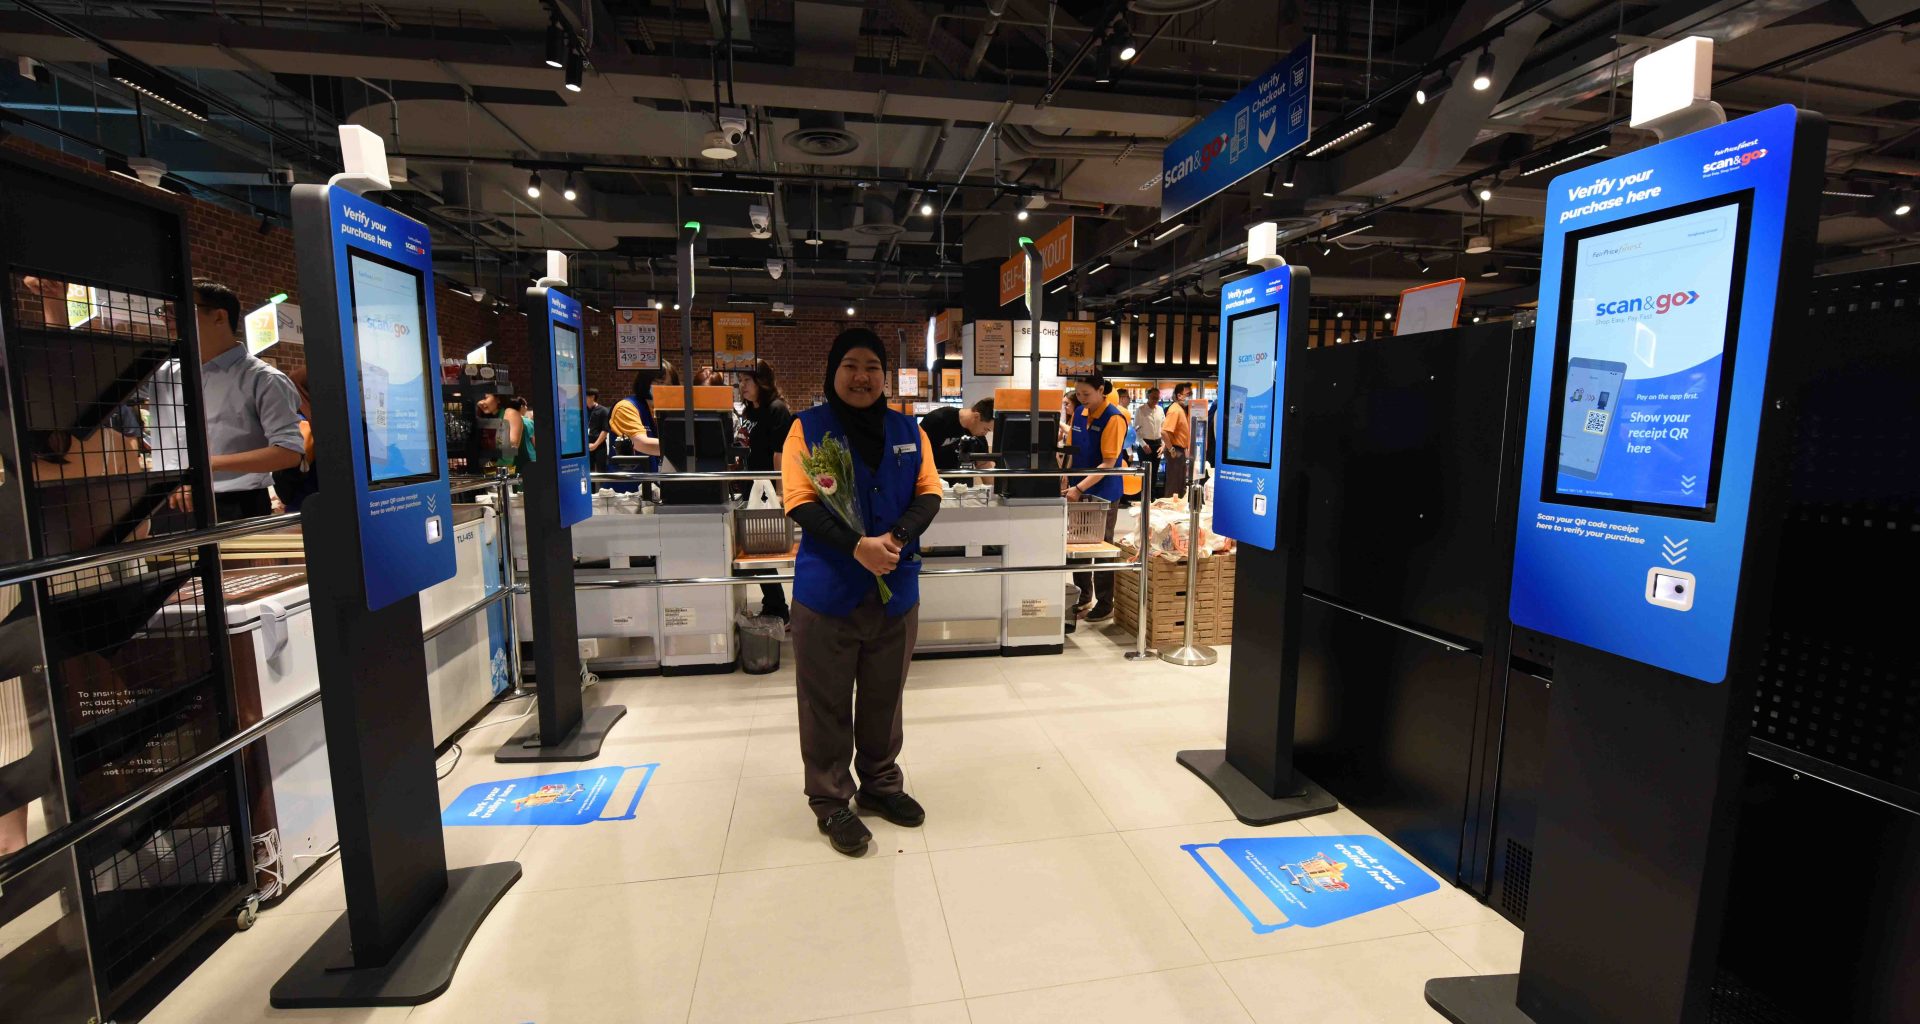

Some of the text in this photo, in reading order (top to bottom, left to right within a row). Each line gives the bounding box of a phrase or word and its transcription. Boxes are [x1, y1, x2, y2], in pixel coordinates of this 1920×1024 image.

[1259, 72, 1280, 95] Verify
[1252, 83, 1286, 113] Checkout
[1260, 105, 1277, 122] Here
[1164, 133, 1226, 188] scan&go
[1703, 149, 1764, 173] scan&go
[1568, 168, 1654, 202] Verify your
[1559, 187, 1662, 224] purchase here
[343, 205, 386, 232] Verify your
[342, 224, 376, 244] purchase
[377, 234, 392, 249] here
[1003, 234, 1067, 294] SELF-CKOUT
[1225, 300, 1244, 311] purchase
[1228, 288, 1242, 300] Verify
[1242, 288, 1254, 297] your
[1596, 291, 1696, 316] scan&go
[1630, 412, 1691, 425] Show your
[1628, 428, 1689, 440] receipt QR
[1626, 443, 1652, 454] here
[1537, 513, 1555, 521] Scan
[1588, 519, 1607, 529] code
[1609, 524, 1639, 533] receipt
[1563, 527, 1585, 536] verify
[1605, 533, 1645, 544] purchase
[468, 801, 488, 816] Park
[1334, 844, 1396, 890] trolley here
[1350, 845, 1406, 885] Park your
